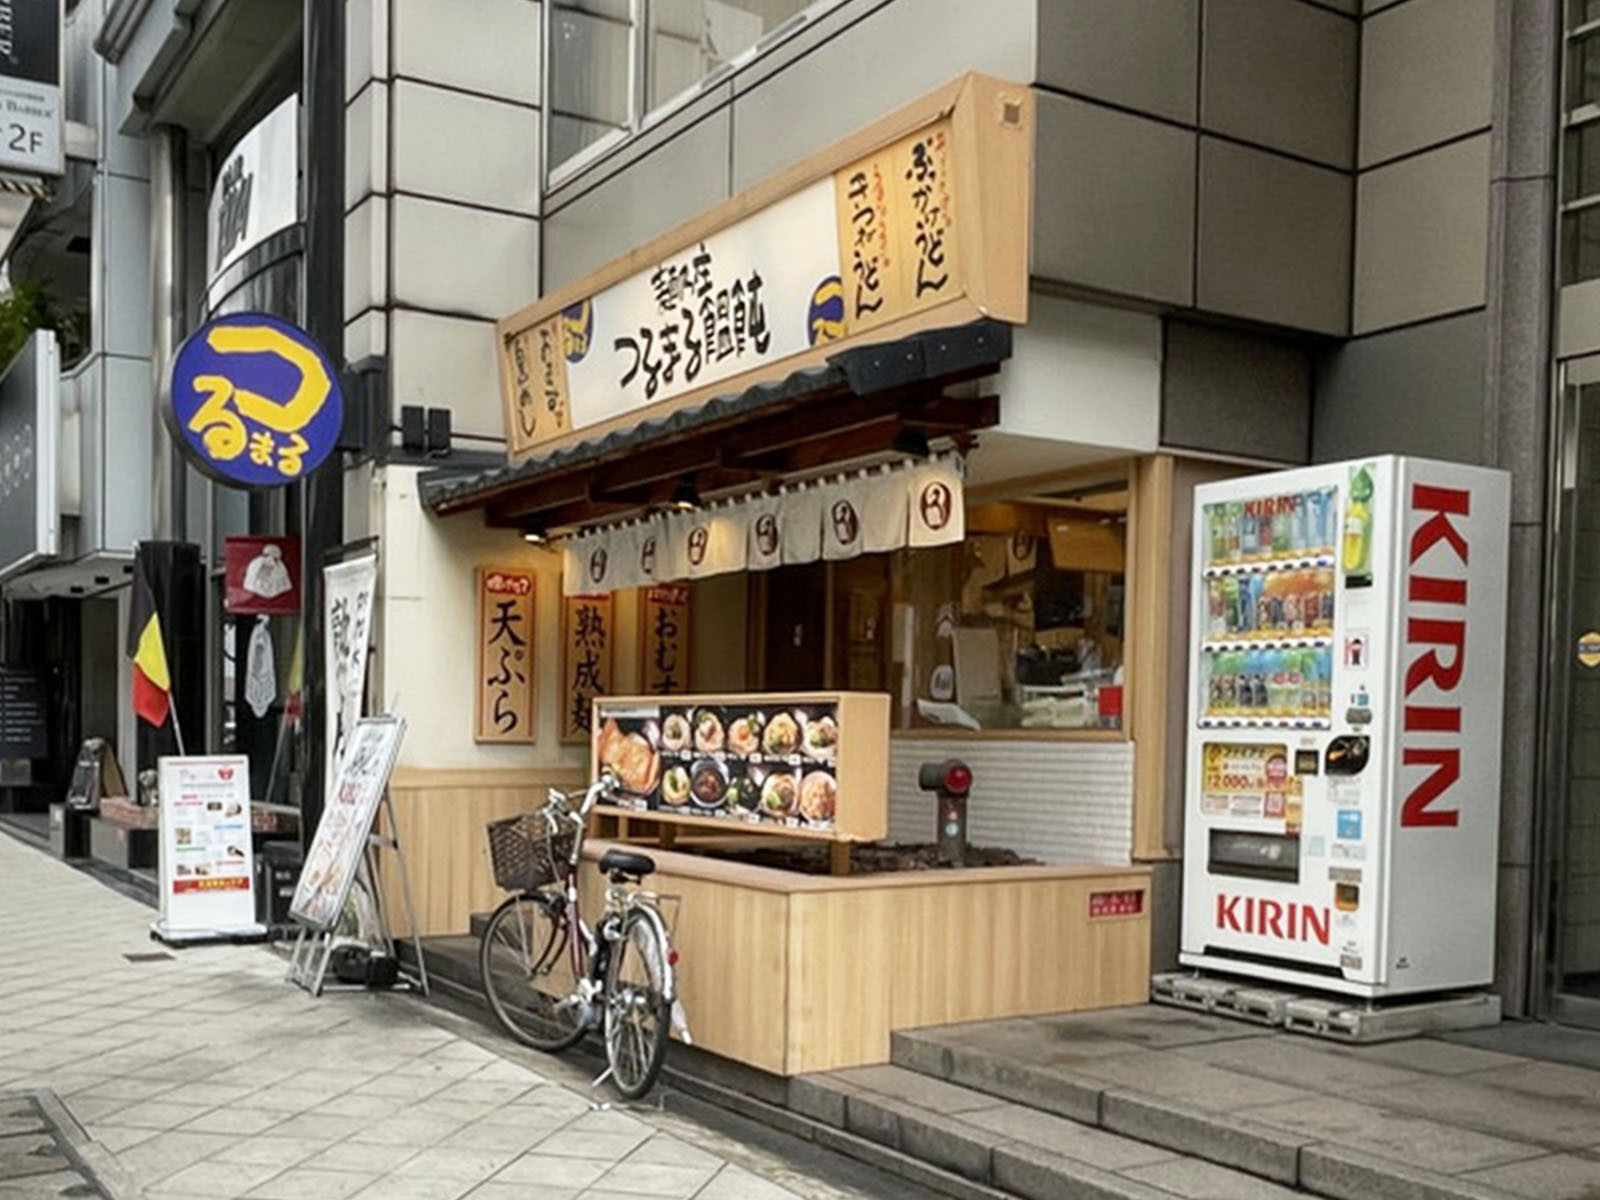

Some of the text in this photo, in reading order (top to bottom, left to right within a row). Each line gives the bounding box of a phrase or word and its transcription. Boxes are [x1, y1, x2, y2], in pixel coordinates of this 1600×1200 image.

[486, 599, 527, 734] 天ぷら
[1401, 483, 1471, 828] KIRIN
[1215, 893, 1331, 946] KIRIN
